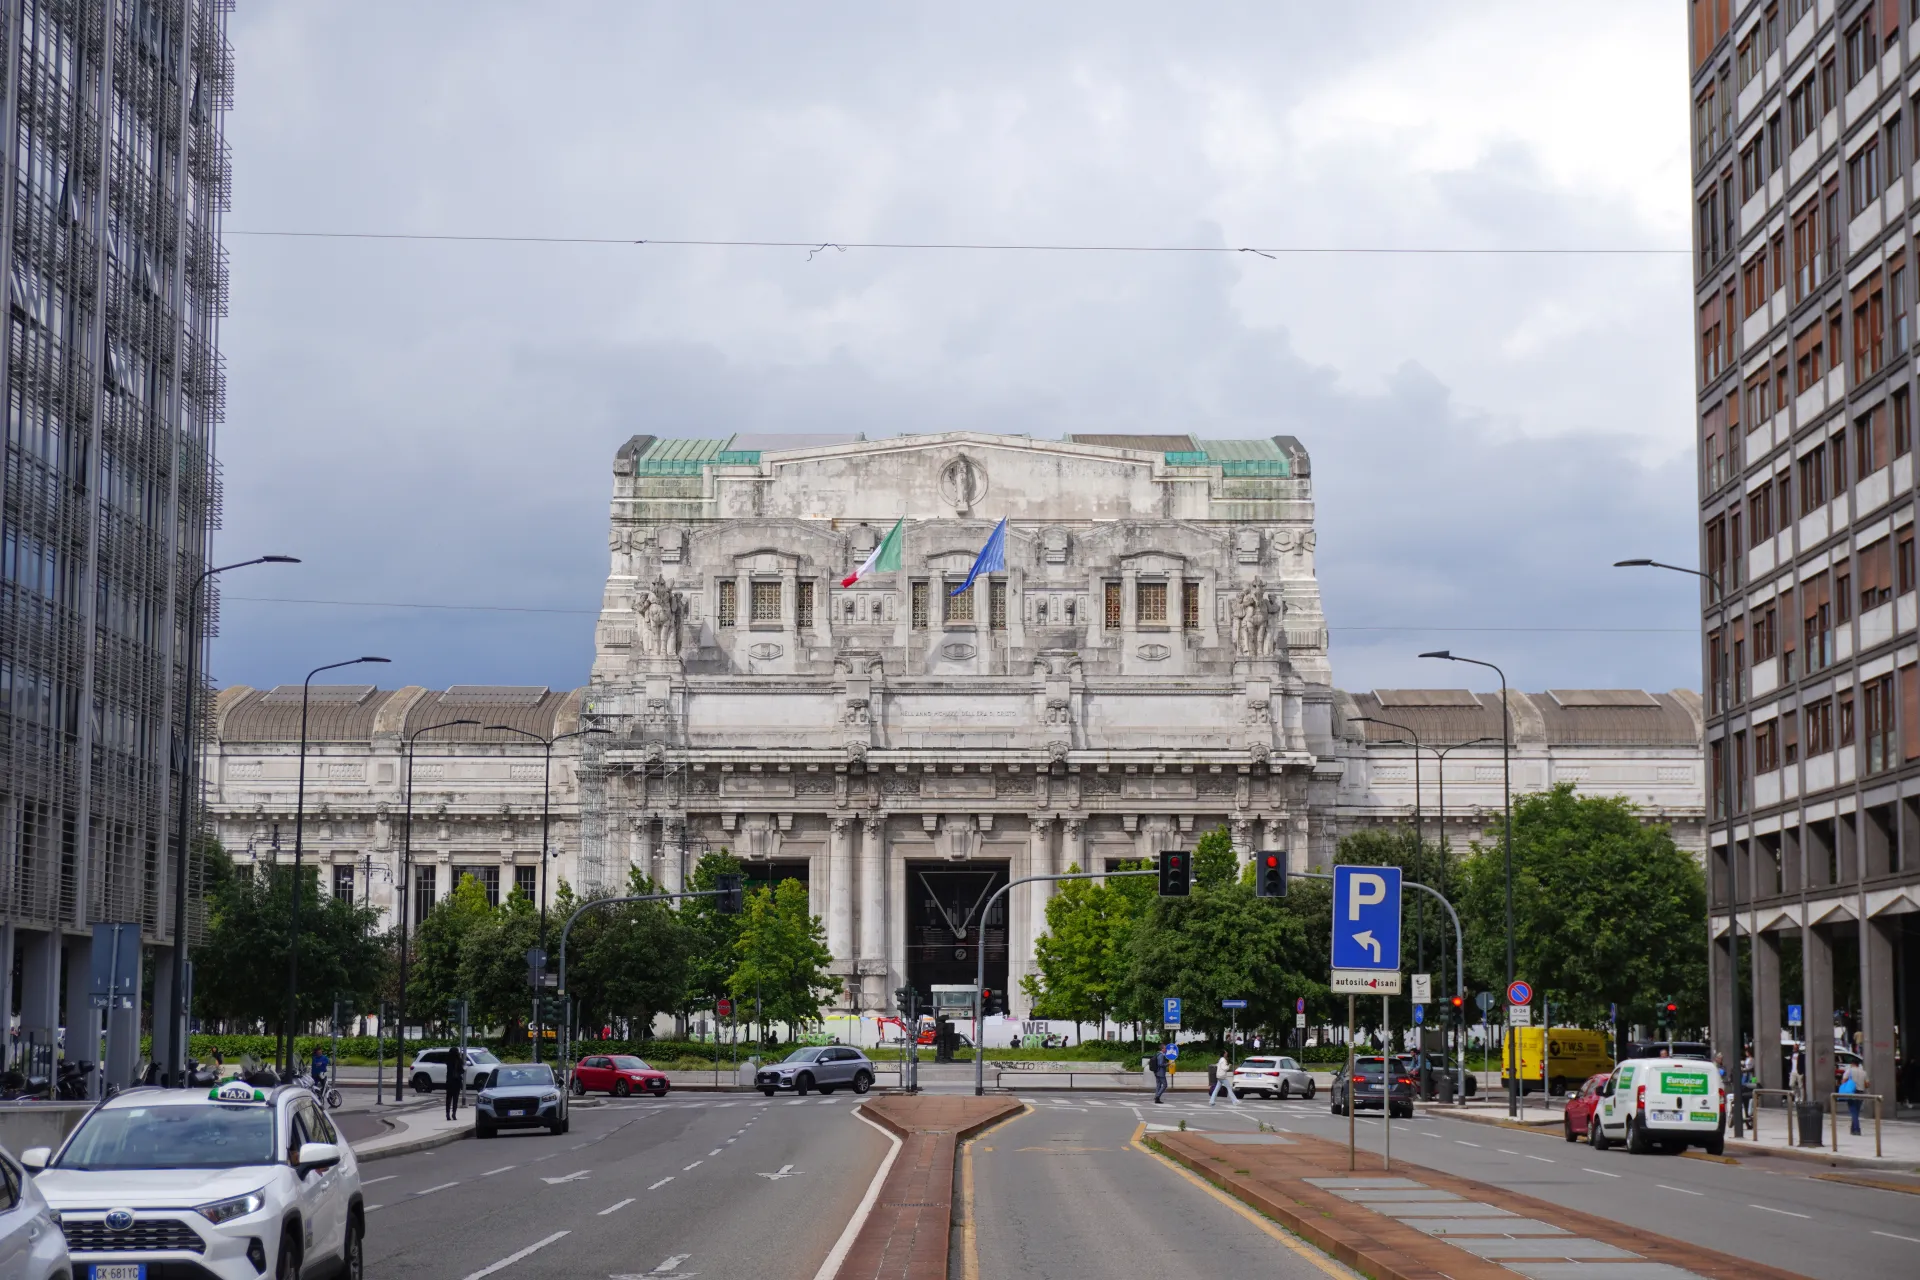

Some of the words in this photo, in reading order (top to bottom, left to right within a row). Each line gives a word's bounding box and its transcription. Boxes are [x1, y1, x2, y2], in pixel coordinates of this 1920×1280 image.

[1349, 873, 1386, 921] P
[1336, 978, 1369, 986] autosilo
[1373, 978, 1397, 987] isani
[1167, 1000, 1177, 1012] P
[1022, 1021, 1052, 1035] WEL
[1561, 1041, 1584, 1052] T.W.S.
[1666, 1076, 1704, 1087] Europcar
[225, 1090, 247, 1099] TAXI
